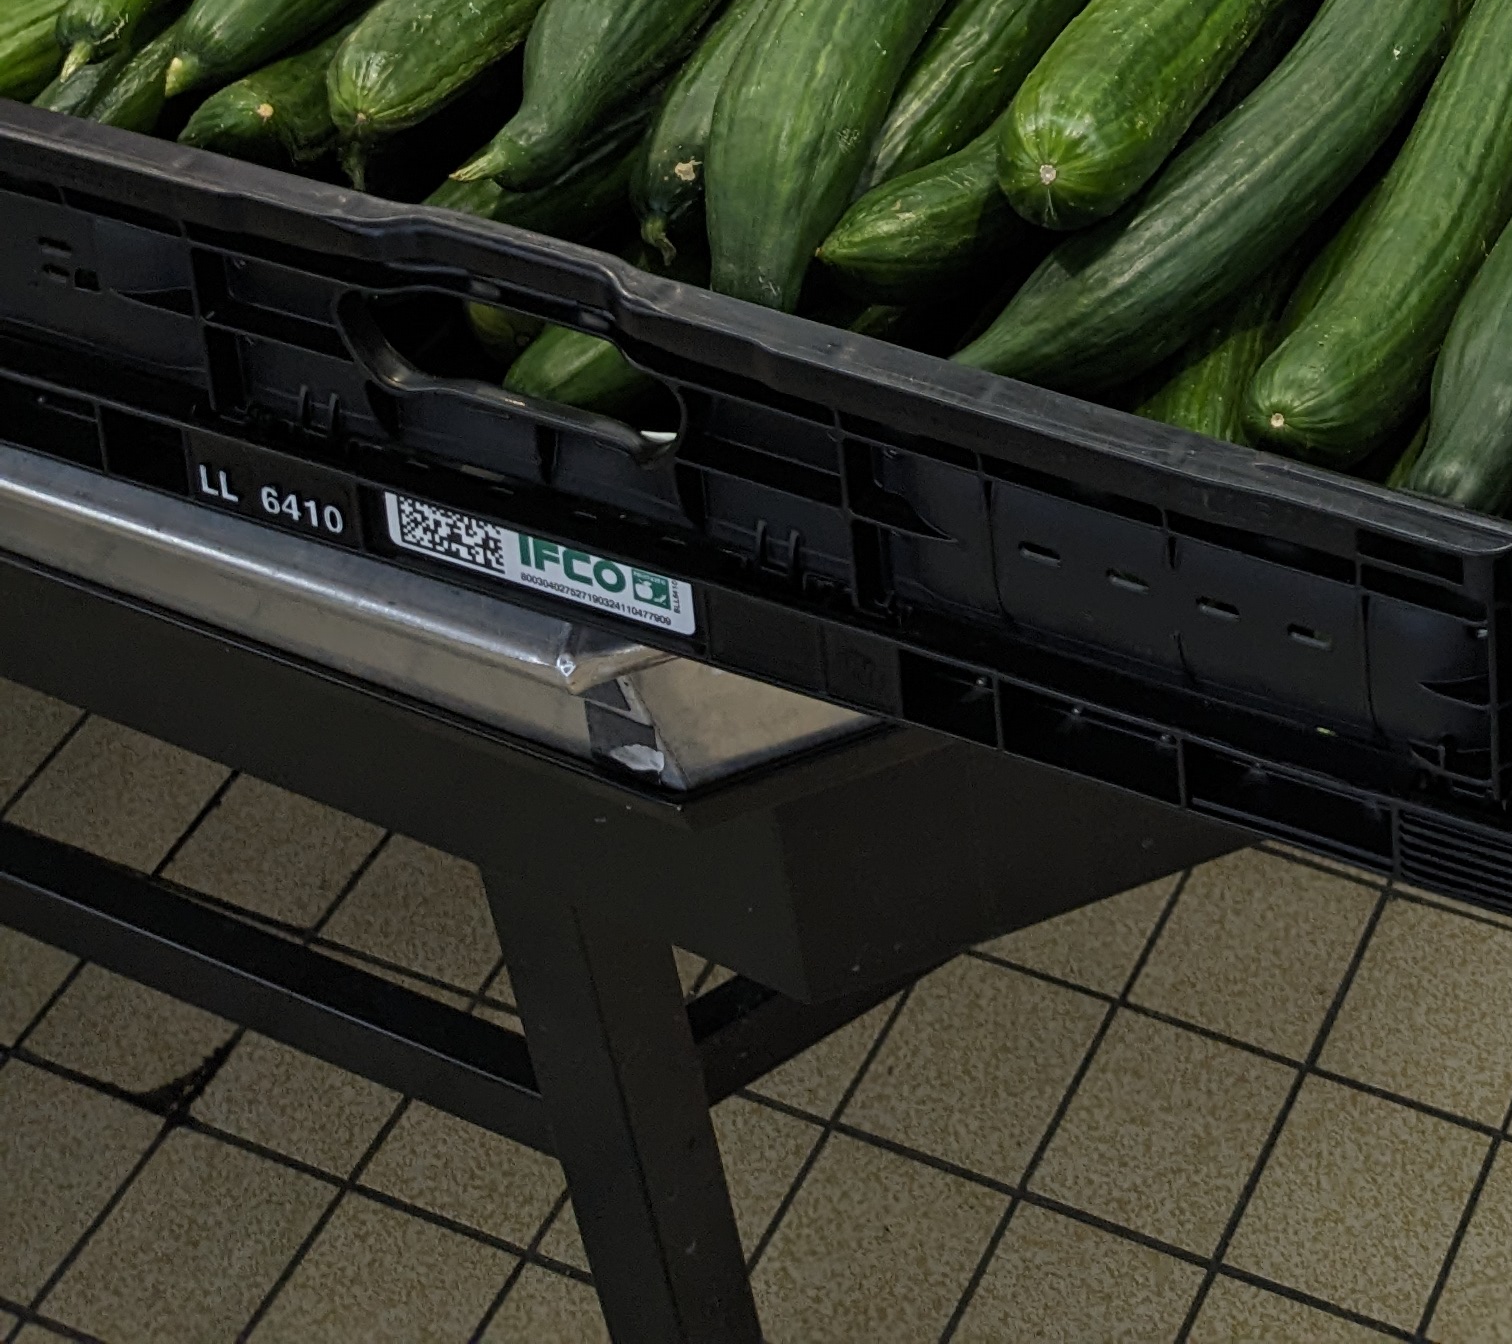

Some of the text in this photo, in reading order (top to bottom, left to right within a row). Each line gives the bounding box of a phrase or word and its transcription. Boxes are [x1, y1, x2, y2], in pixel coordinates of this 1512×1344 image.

[200, 464, 344, 534] LL 6410
[518, 533, 626, 593] IFCO
